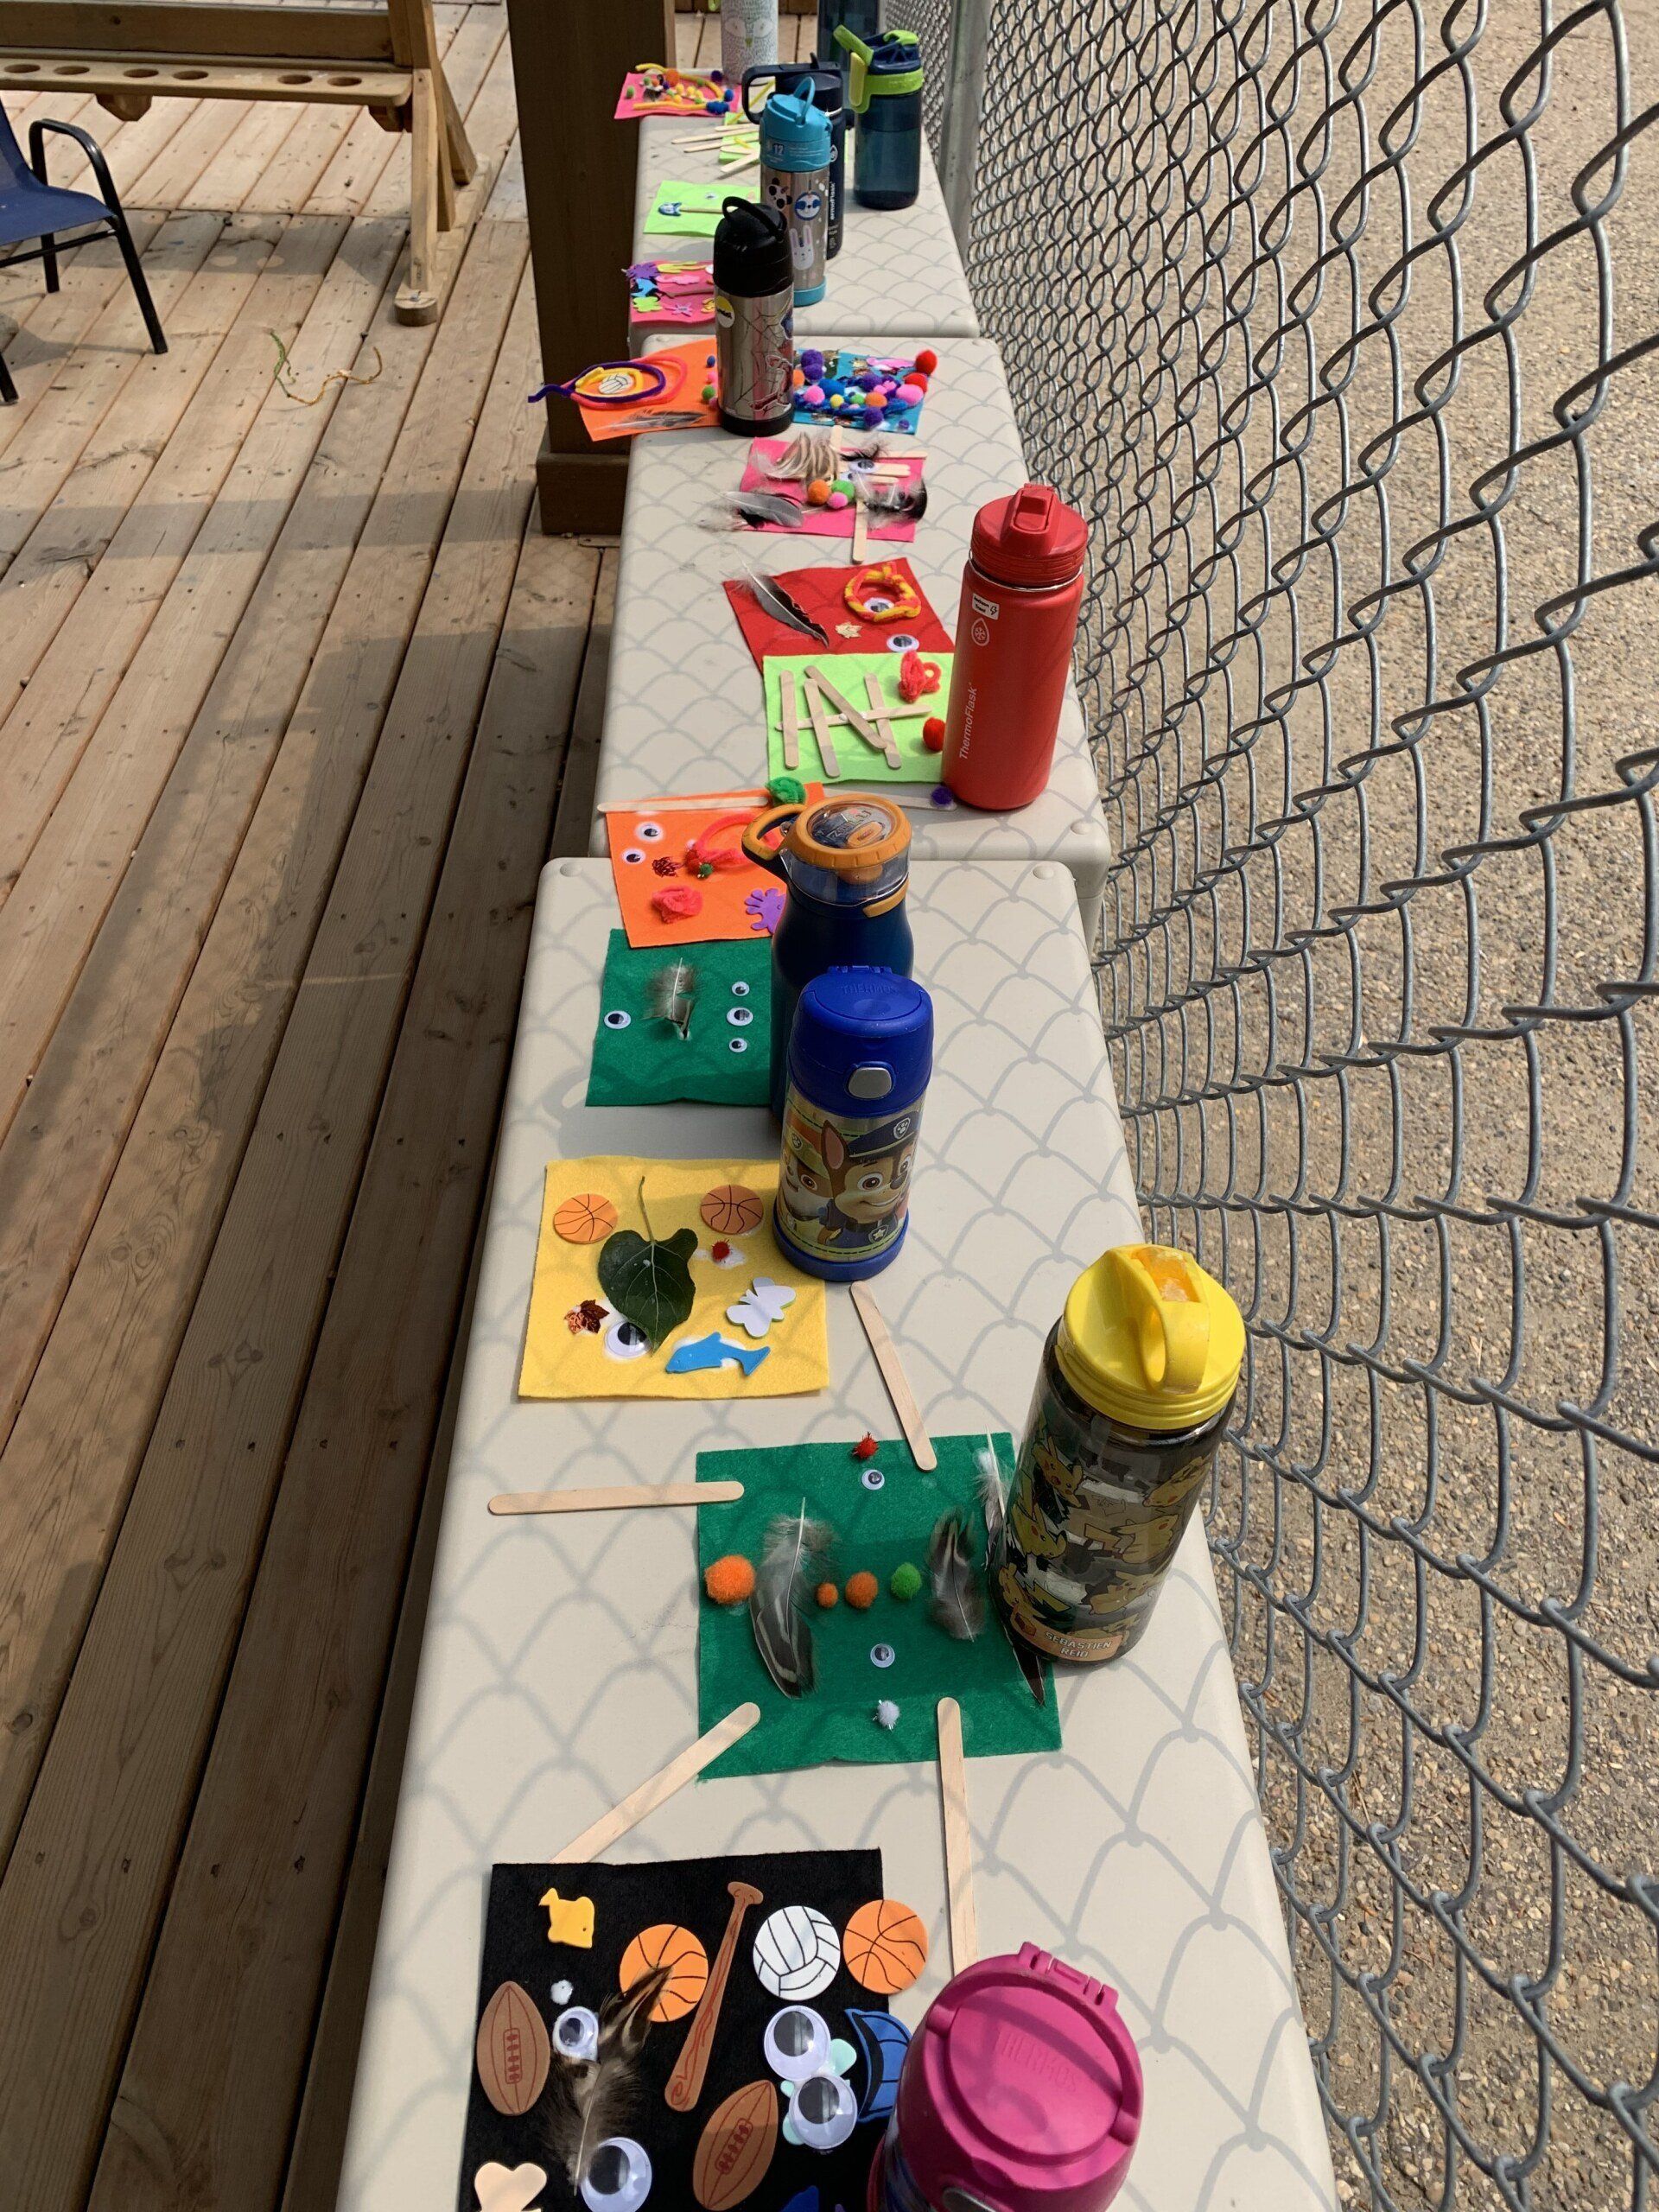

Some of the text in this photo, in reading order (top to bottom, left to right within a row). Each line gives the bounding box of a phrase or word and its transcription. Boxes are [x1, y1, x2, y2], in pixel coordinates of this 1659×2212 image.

[959, 686, 977, 760] ThermoFlask
[1046, 1632, 1111, 1649] SEBASTIEN
[1060, 1647, 1089, 1658] REID
